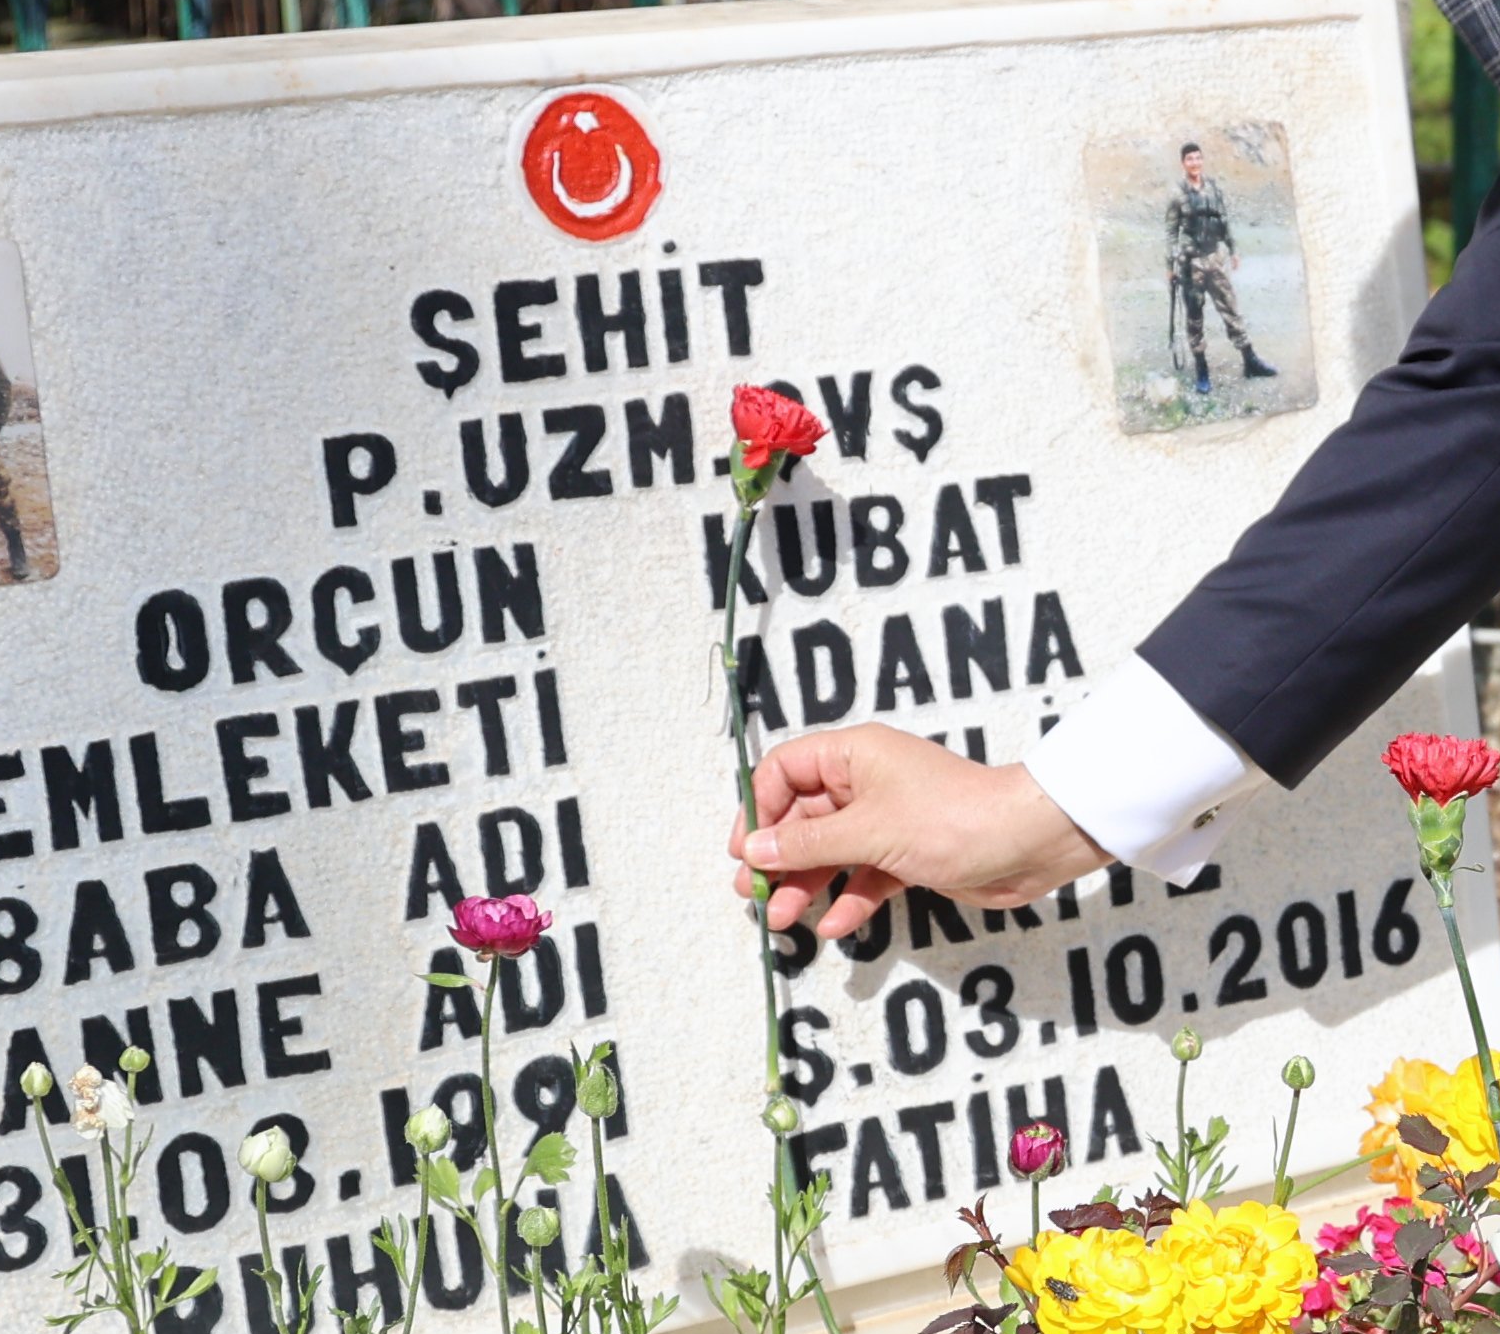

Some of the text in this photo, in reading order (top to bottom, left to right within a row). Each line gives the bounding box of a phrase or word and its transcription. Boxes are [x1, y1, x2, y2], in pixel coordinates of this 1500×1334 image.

[410, 240, 764, 399] ŞEHİT
[135, 473, 1032, 693] ORÇUN KUBAT
[730, 591, 1085, 739] ADANA
[406, 796, 590, 923] ADI
[419, 922, 607, 1052] ADI
[789, 1064, 1143, 1219] FATİHA
